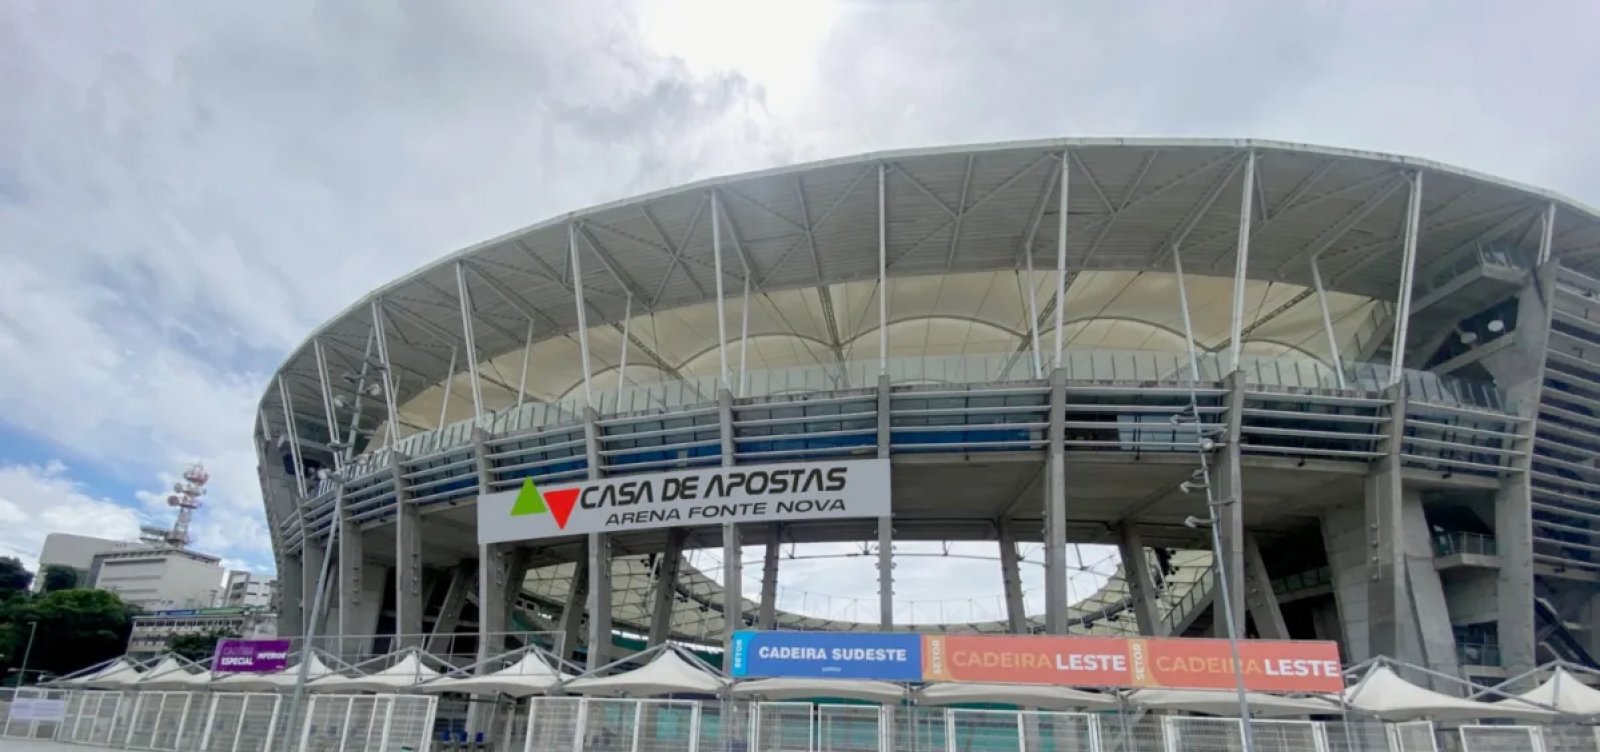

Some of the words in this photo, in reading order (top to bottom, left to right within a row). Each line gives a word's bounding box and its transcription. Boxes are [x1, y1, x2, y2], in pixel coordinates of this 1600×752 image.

[581, 480, 653, 509] CASA
[661, 476, 699, 502] DE
[703, 467, 847, 499] APOSTAS
[605, 508, 681, 526] ARENA
[688, 502, 767, 519] FONTE
[776, 499, 846, 513] NOVA
[221, 657, 254, 665] ESPECIAL
[759, 646, 827, 660] CADEIRA
[832, 647, 907, 661] SUDESTE
[932, 640, 942, 675] SETOR
[952, 651, 1052, 668] CADEIRA
[1055, 653, 1127, 671] LESTE
[1132, 643, 1144, 680] SETOR
[1264, 658, 1339, 677] LESTE
